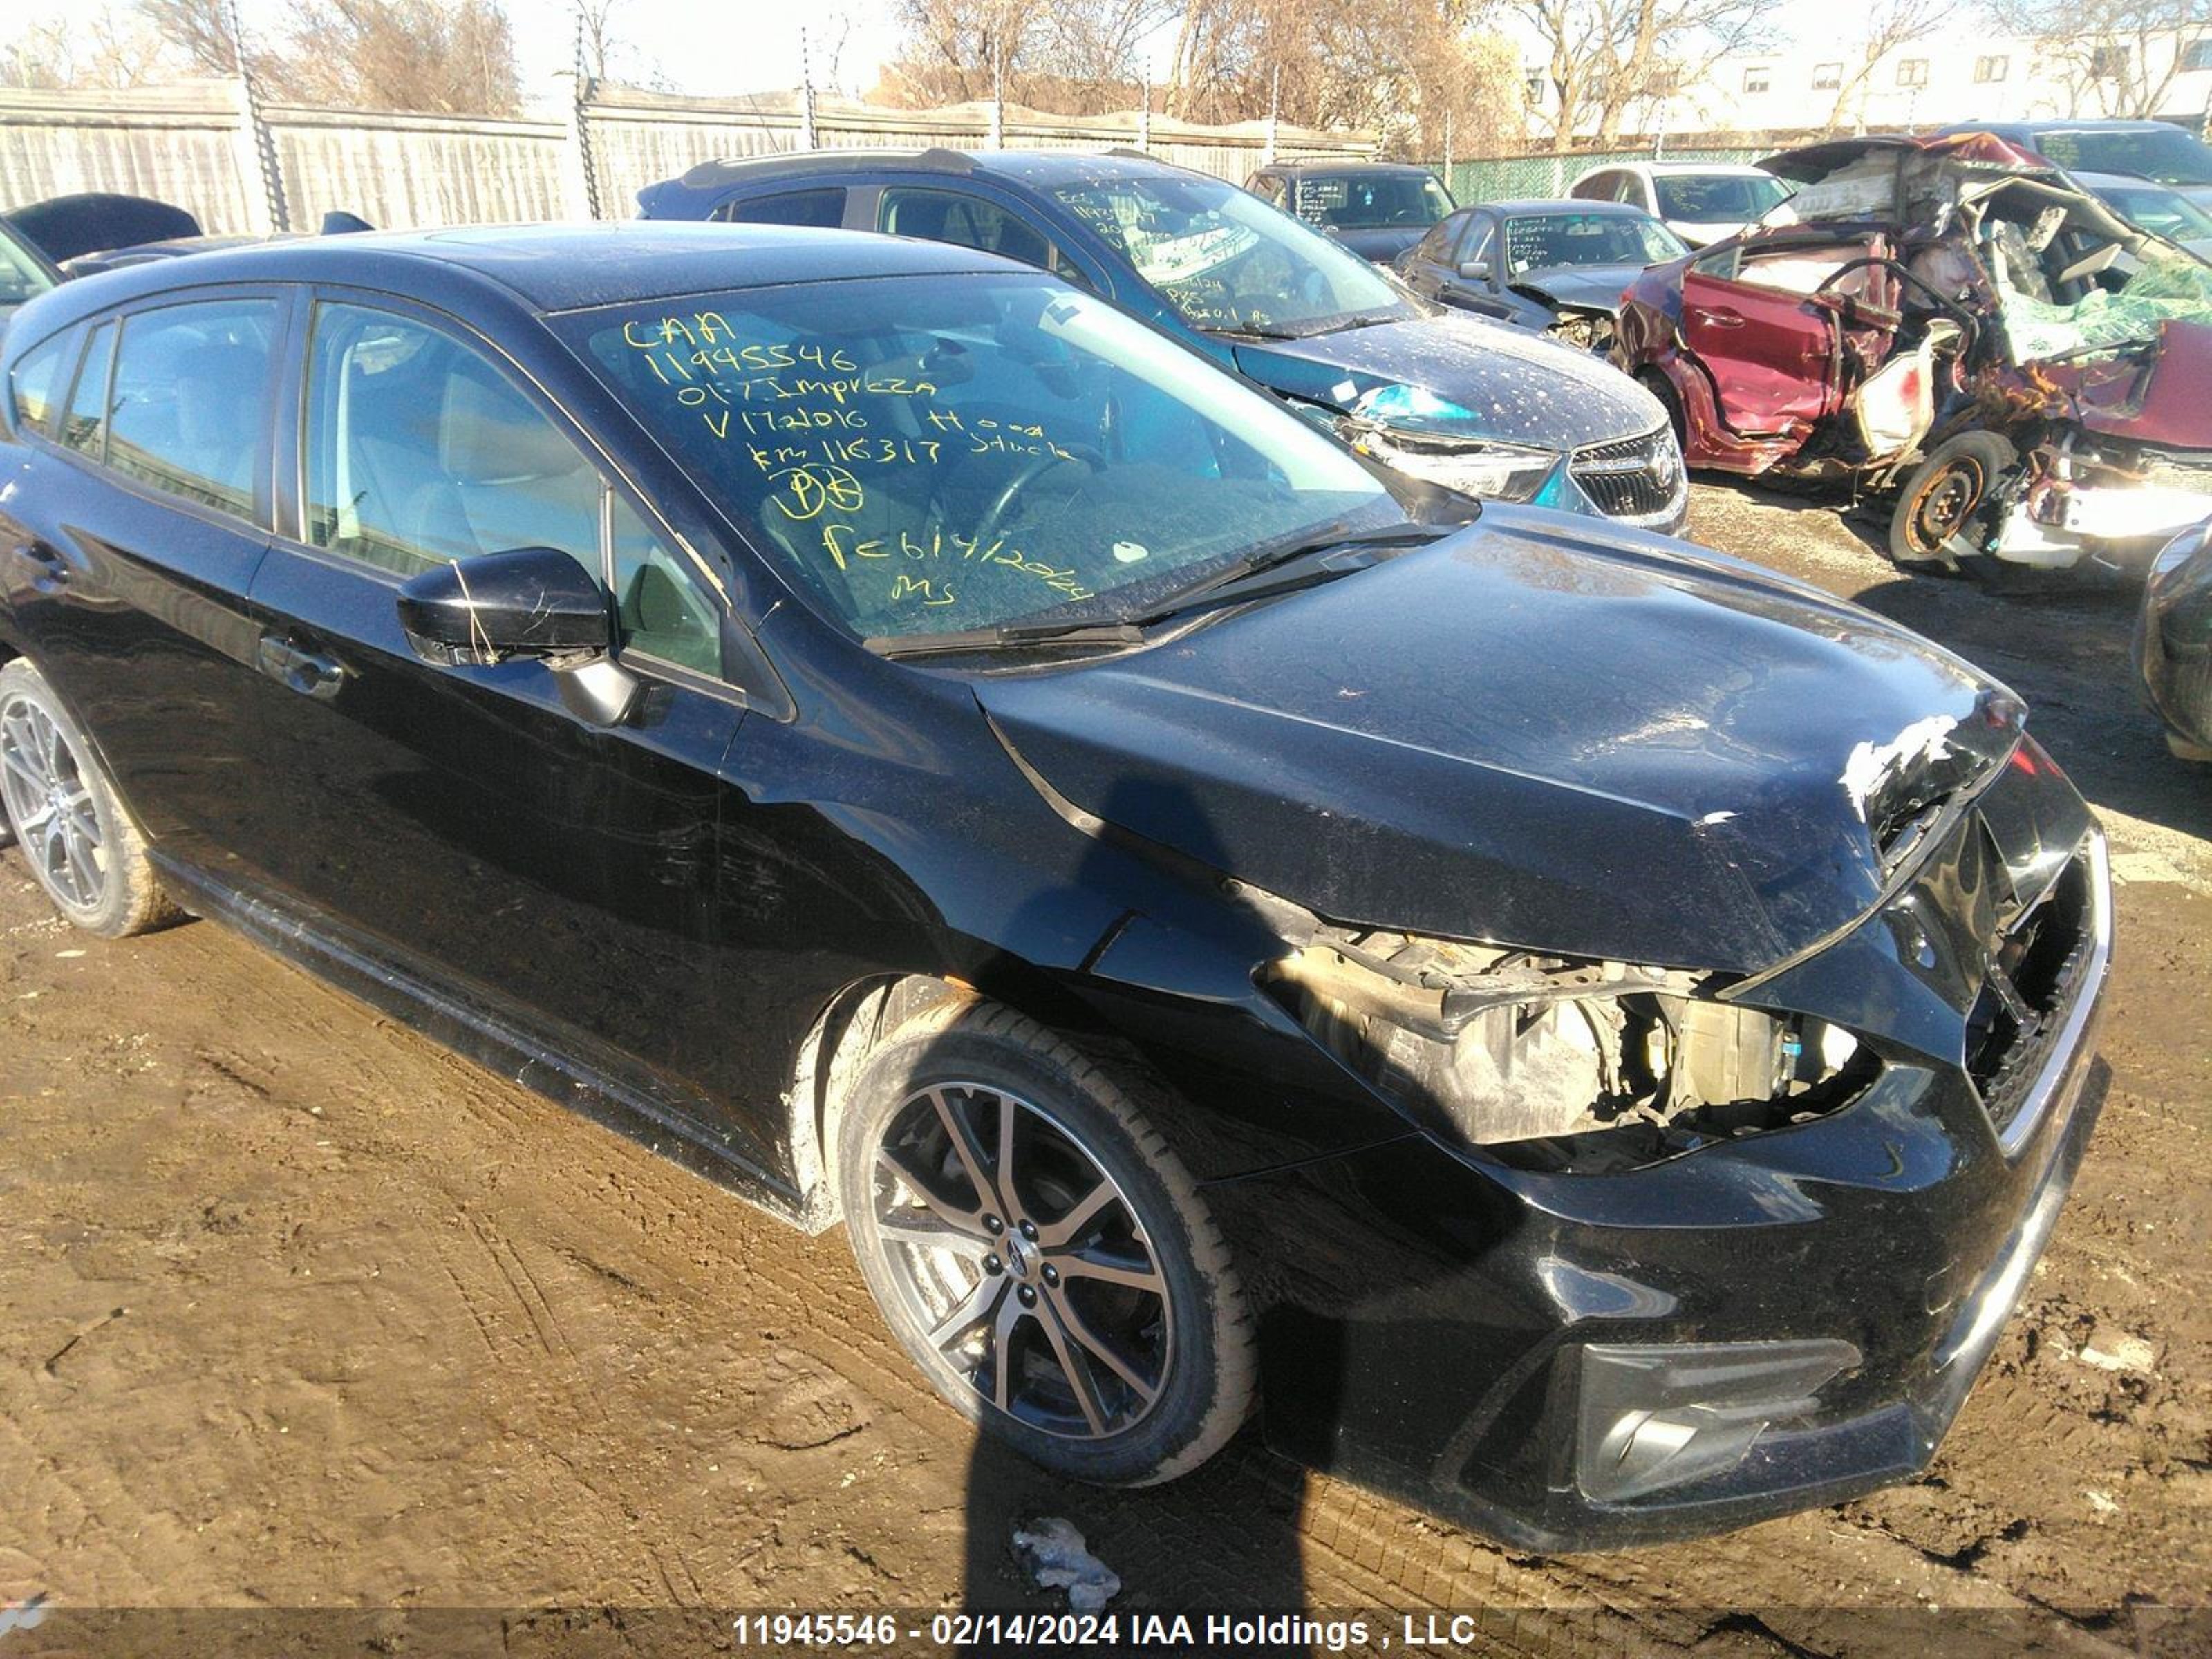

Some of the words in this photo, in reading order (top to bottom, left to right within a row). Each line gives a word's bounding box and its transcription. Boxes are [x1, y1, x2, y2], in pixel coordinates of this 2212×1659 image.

[624, 312, 736, 347] CAA
[644, 345, 858, 384] 11945546
[821, 438, 941, 465] 116317
